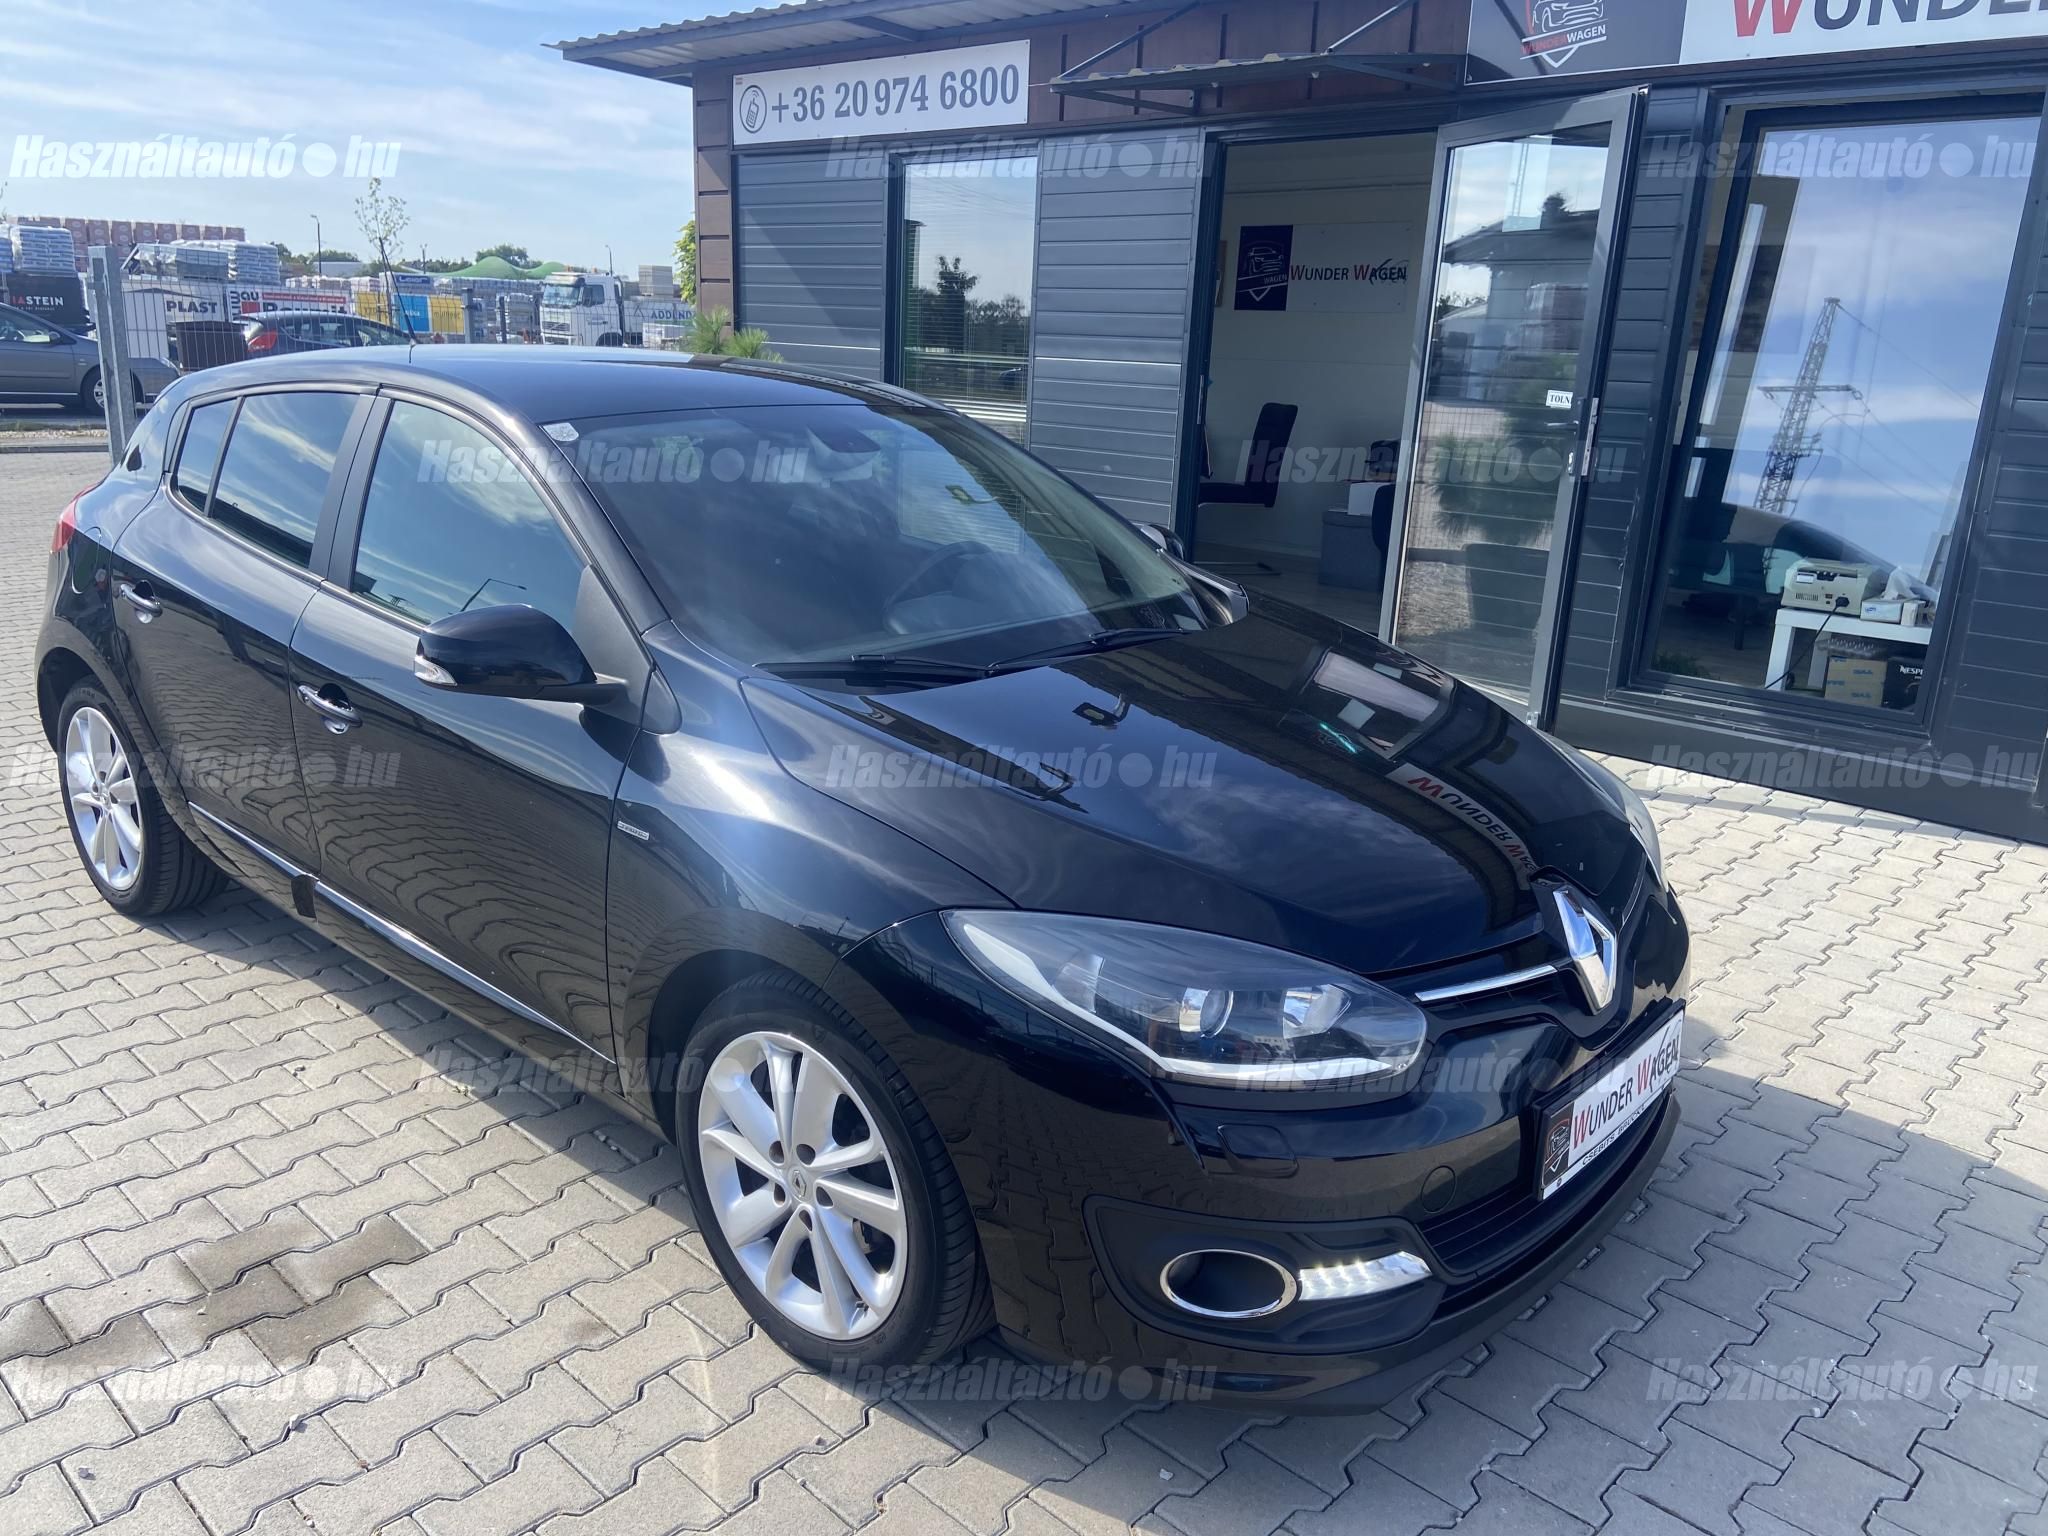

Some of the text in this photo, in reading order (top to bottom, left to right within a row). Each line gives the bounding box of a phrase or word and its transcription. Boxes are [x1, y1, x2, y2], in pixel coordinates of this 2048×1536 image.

[1567, 24, 1606, 42] WAGEN
[771, 64, 1020, 123] +36 20 974 6800
[1291, 261, 1408, 284] WUNDER WAGEN
[166, 300, 218, 314] PLAST
[1573, 1033, 1680, 1150] WUNDER WAGEN
